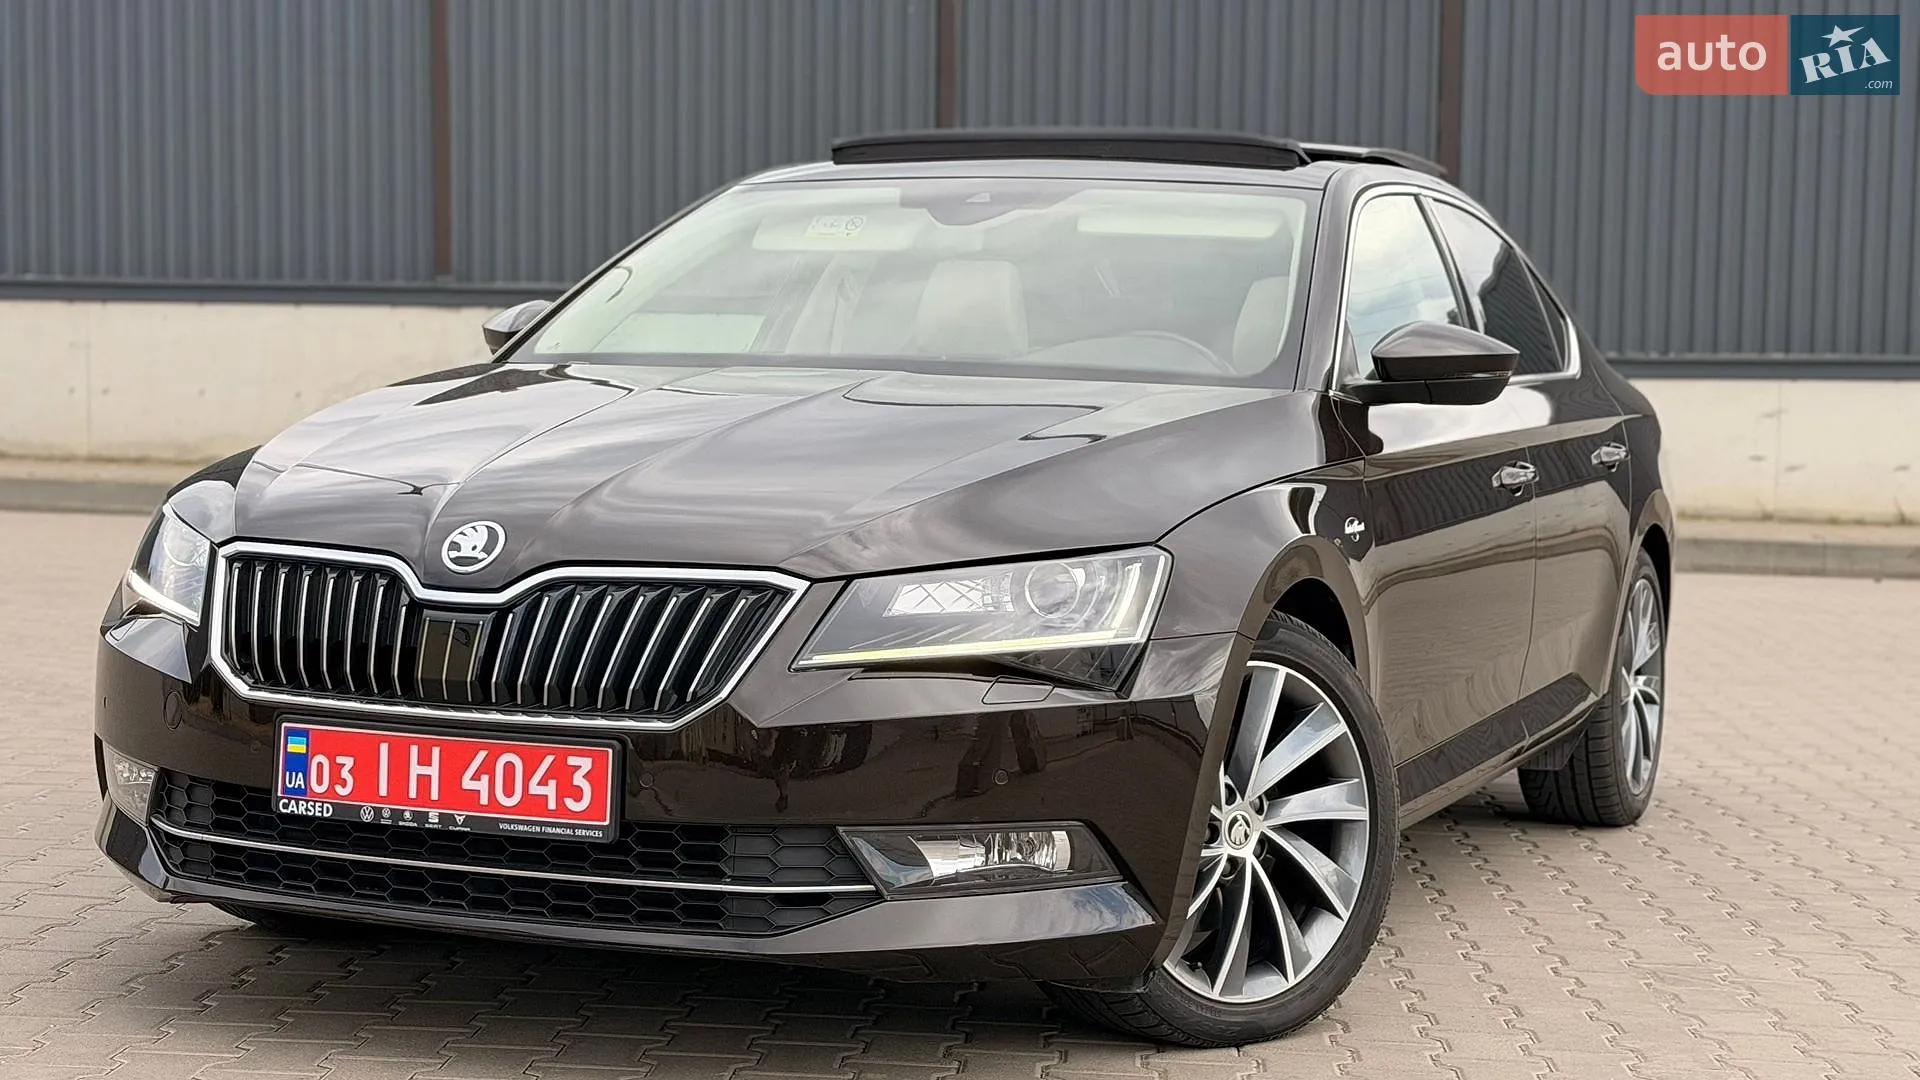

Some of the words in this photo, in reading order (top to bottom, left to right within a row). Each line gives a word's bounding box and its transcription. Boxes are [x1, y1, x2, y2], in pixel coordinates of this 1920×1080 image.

[285, 771, 305, 789] UA
[310, 753, 355, 796] 03
[461, 750, 593, 812] 4043
[279, 799, 333, 818] CARSED
[499, 822, 541, 834] VOLKSWAGEN
[541, 826, 574, 836] FINANCIAL
[574, 828, 603, 838] SERVICES
